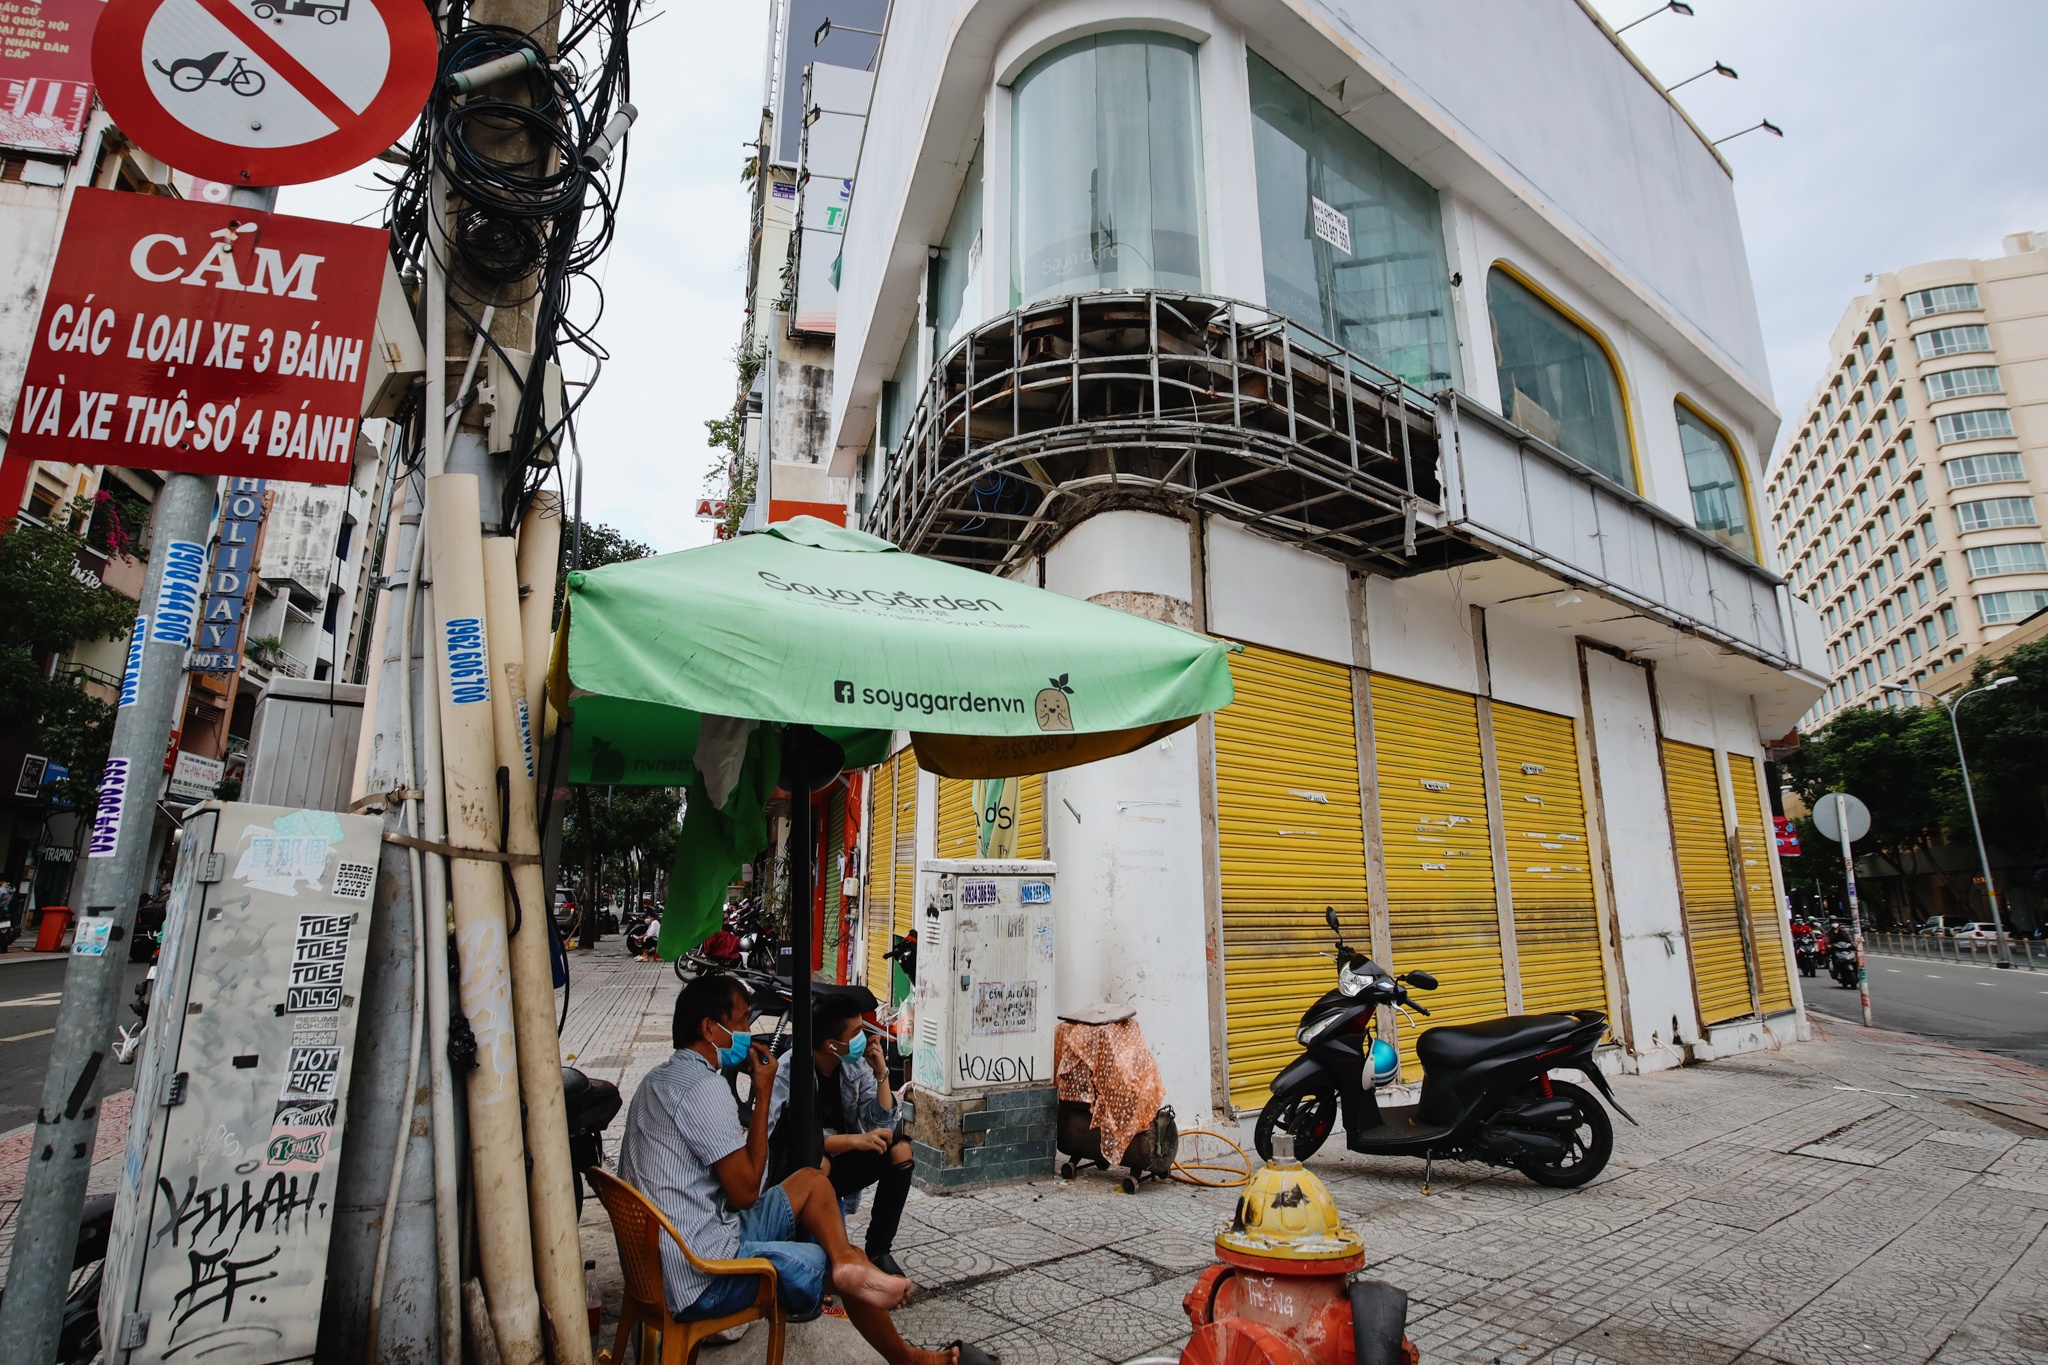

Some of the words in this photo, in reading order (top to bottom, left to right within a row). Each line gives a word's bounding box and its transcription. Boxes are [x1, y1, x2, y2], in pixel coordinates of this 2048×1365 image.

[827, 206, 846, 228] T
[130, 222, 326, 301] CẤM
[48, 293, 115, 356] CÁC
[127, 313, 203, 378] LOẠI
[203, 321, 250, 370] XE
[253, 328, 275, 374] 3
[277, 320, 364, 383] BÁNH
[21, 374, 66, 437] VÀ
[68, 390, 119, 441] XE
[124, 389, 190, 449] THÔ
[193, 396, 242, 453] SƠ
[241, 409, 264, 455] 4
[266, 399, 355, 464] BÁNH
[70, 557, 102, 590] hite
[153, 543, 205, 644] 0908.444.606
[979, 620, 1032, 630] Chain
[446, 618, 486, 704] 0962.606.700
[863, 688, 1025, 715] soyagardenvn
[299, 915, 351, 938] TOES
[295, 938, 348, 962] TOES
[292, 962, 345, 985] TOES
[293, 1049, 340, 1070] HOT
